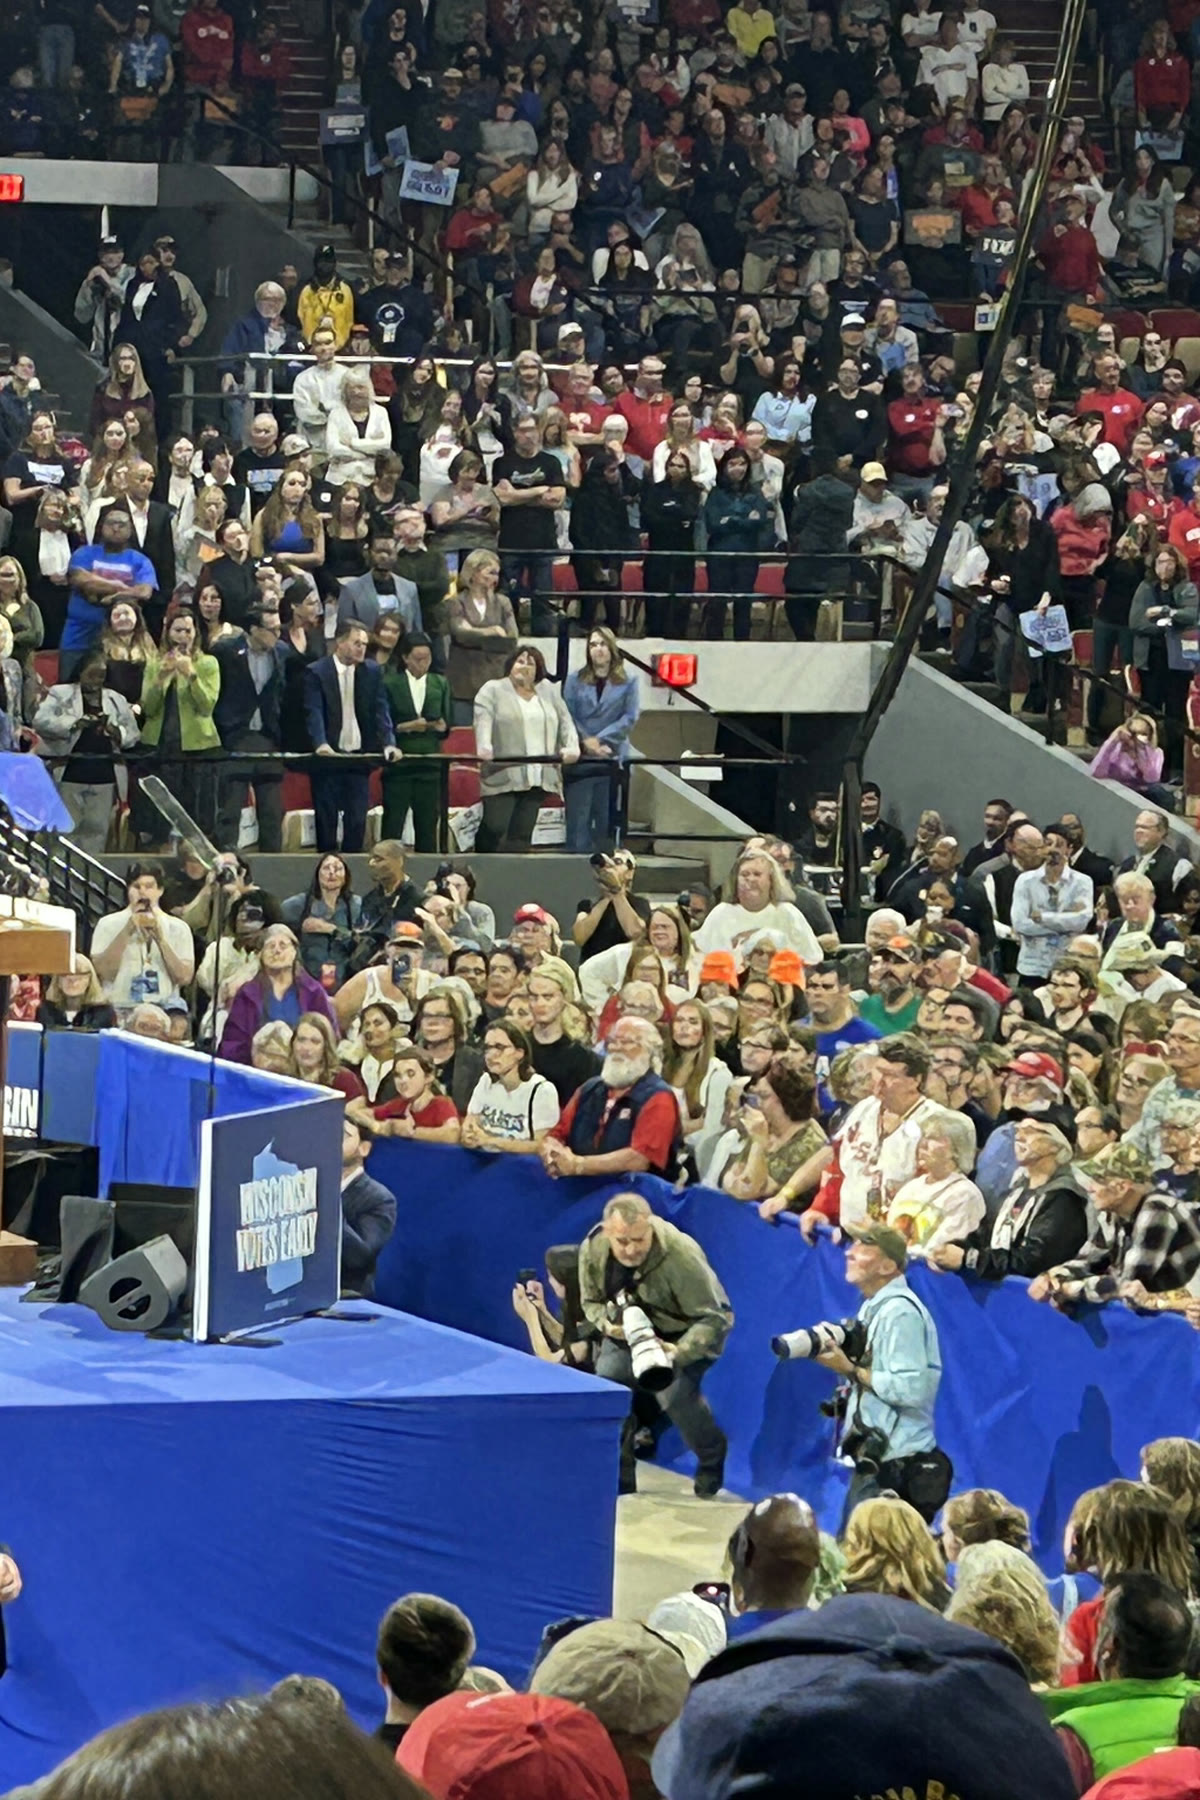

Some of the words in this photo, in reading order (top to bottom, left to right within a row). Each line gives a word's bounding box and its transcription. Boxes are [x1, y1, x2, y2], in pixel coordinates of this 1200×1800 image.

[239, 1166, 318, 1227] WISCONSIN
[236, 1221, 279, 1273] VOTES
[280, 1211, 318, 1261] EARLY
